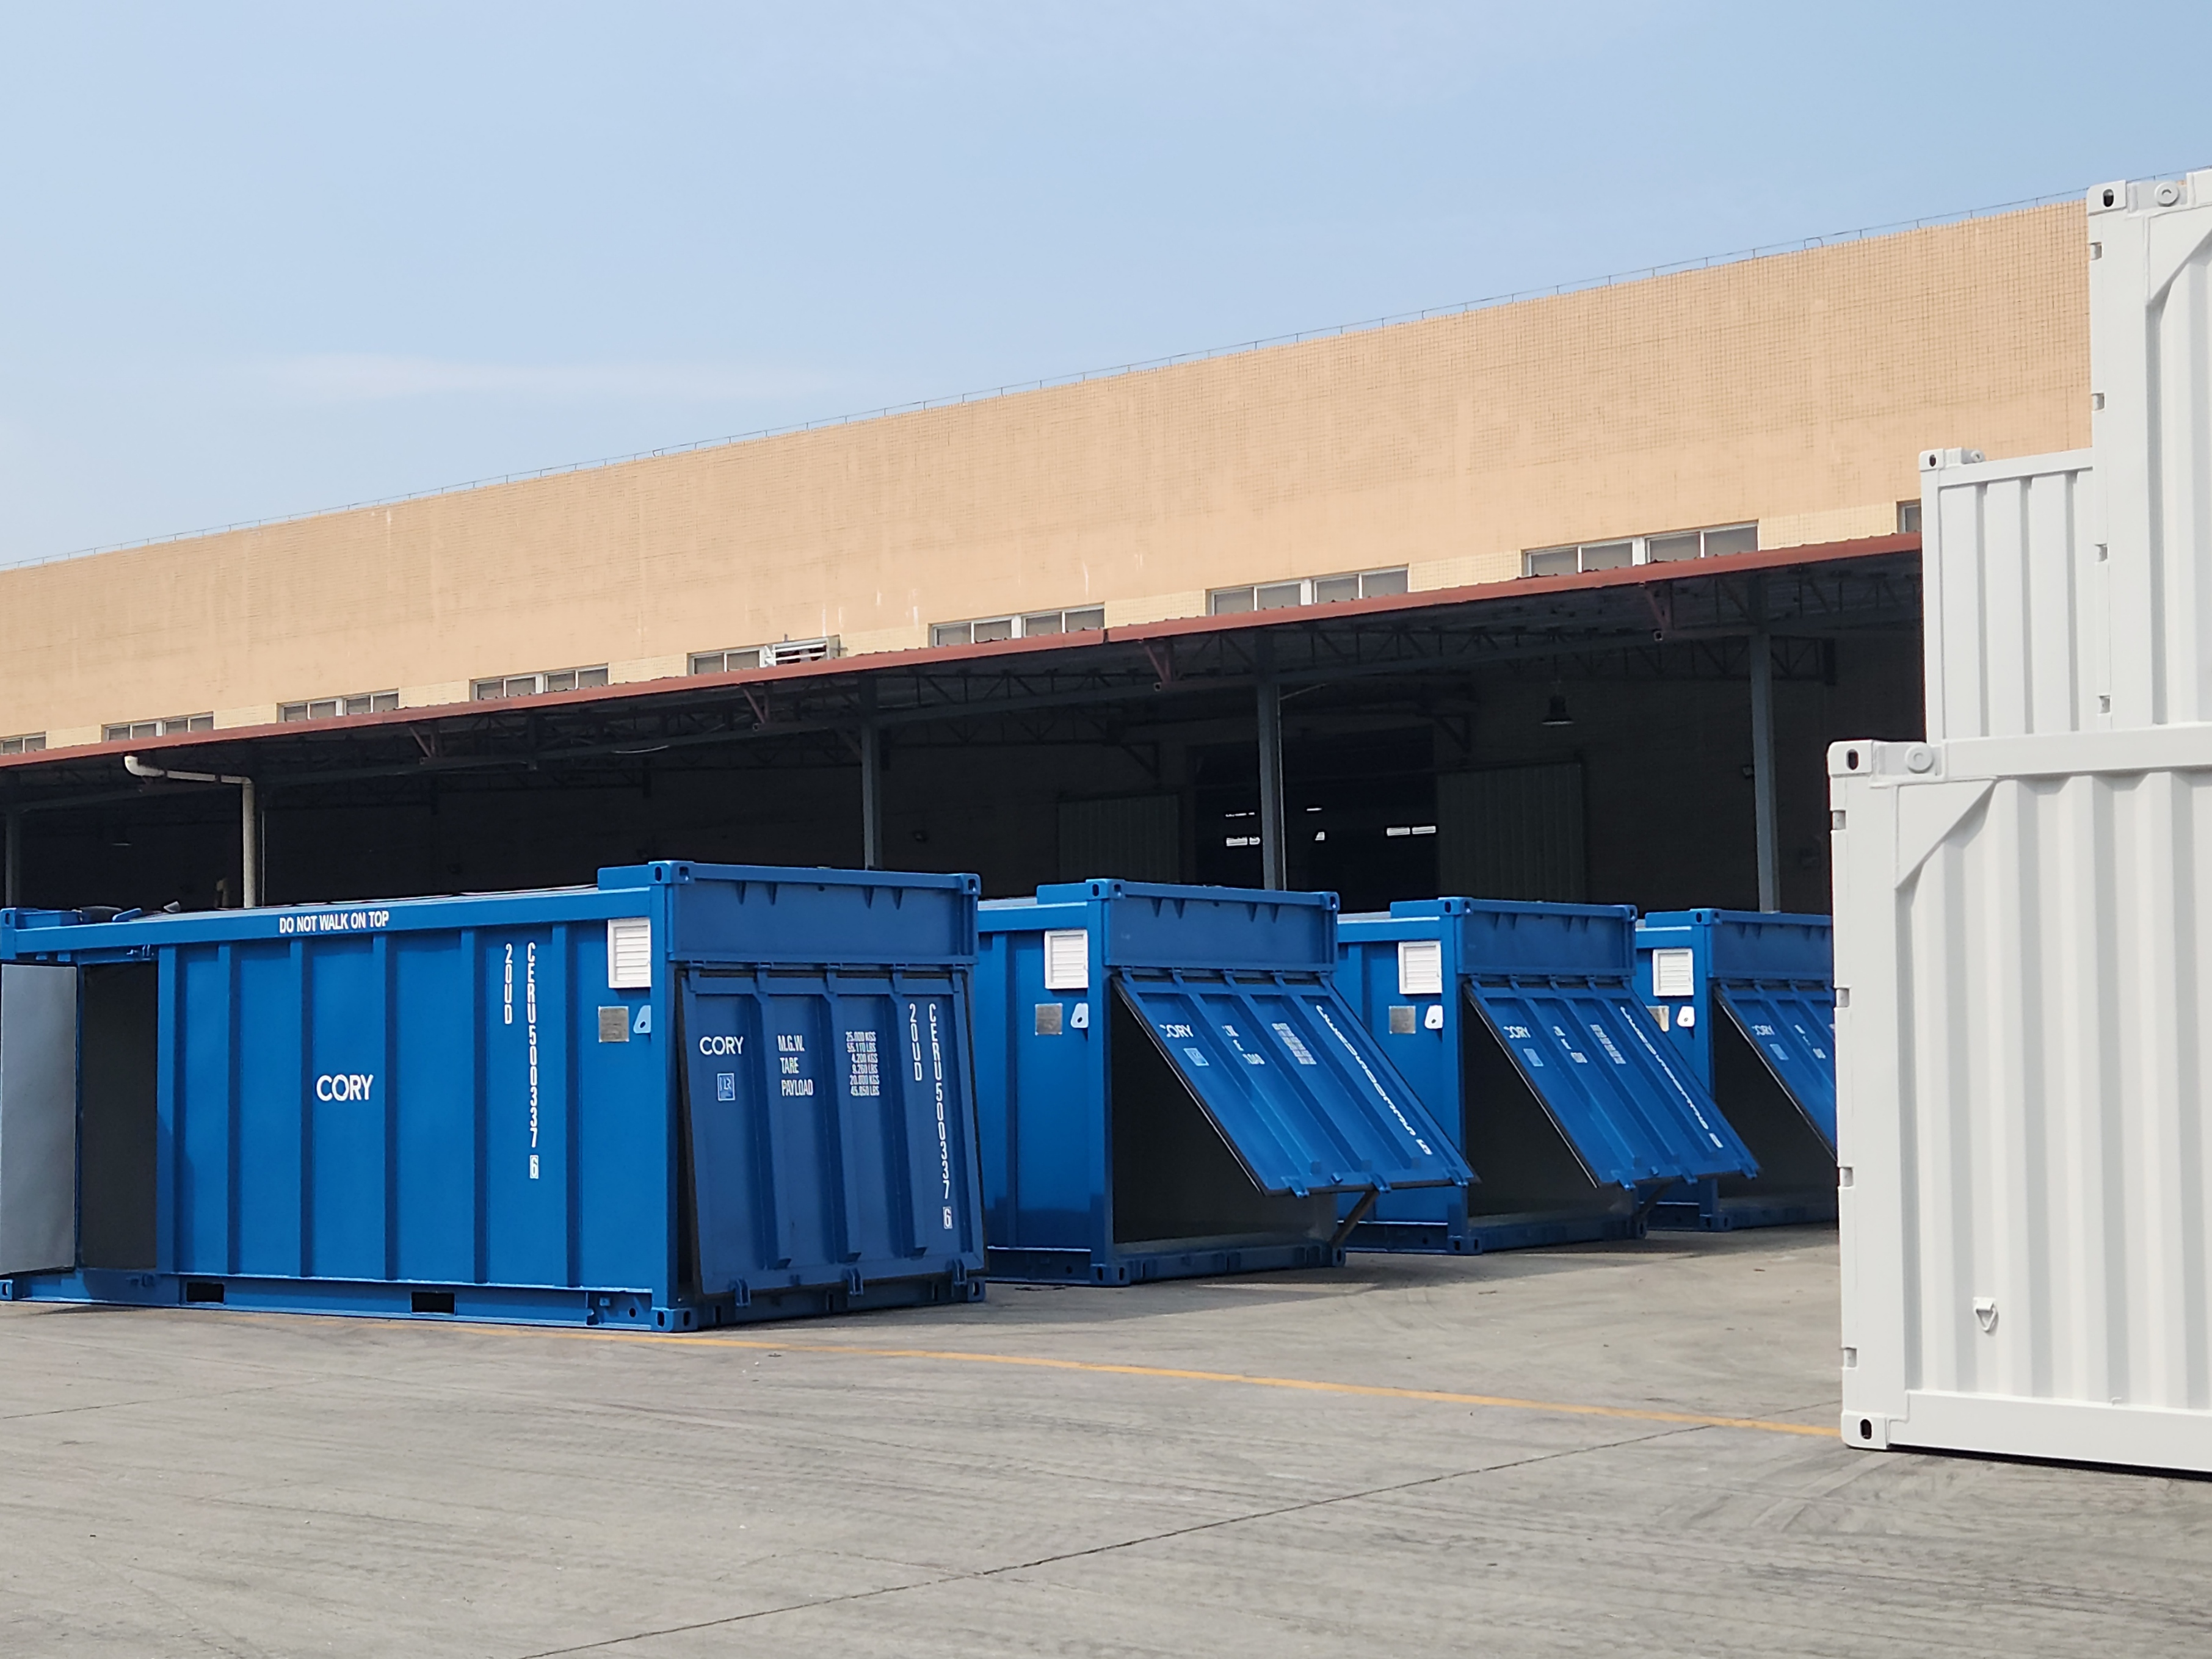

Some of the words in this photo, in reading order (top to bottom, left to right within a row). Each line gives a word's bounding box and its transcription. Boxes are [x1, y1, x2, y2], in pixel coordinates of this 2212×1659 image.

[279, 917, 295, 934] DO
[296, 915, 318, 932] NOT
[319, 913, 349, 931] WALK
[350, 911, 366, 929] ON
[368, 910, 390, 928] TOP
[699, 1036, 744, 1055] CORY
[777, 1035, 805, 1052] M.G.W.
[779, 1057, 800, 1074] TARE
[316, 1074, 374, 1101] CORY
[781, 1079, 814, 1097] PAYLOAD
